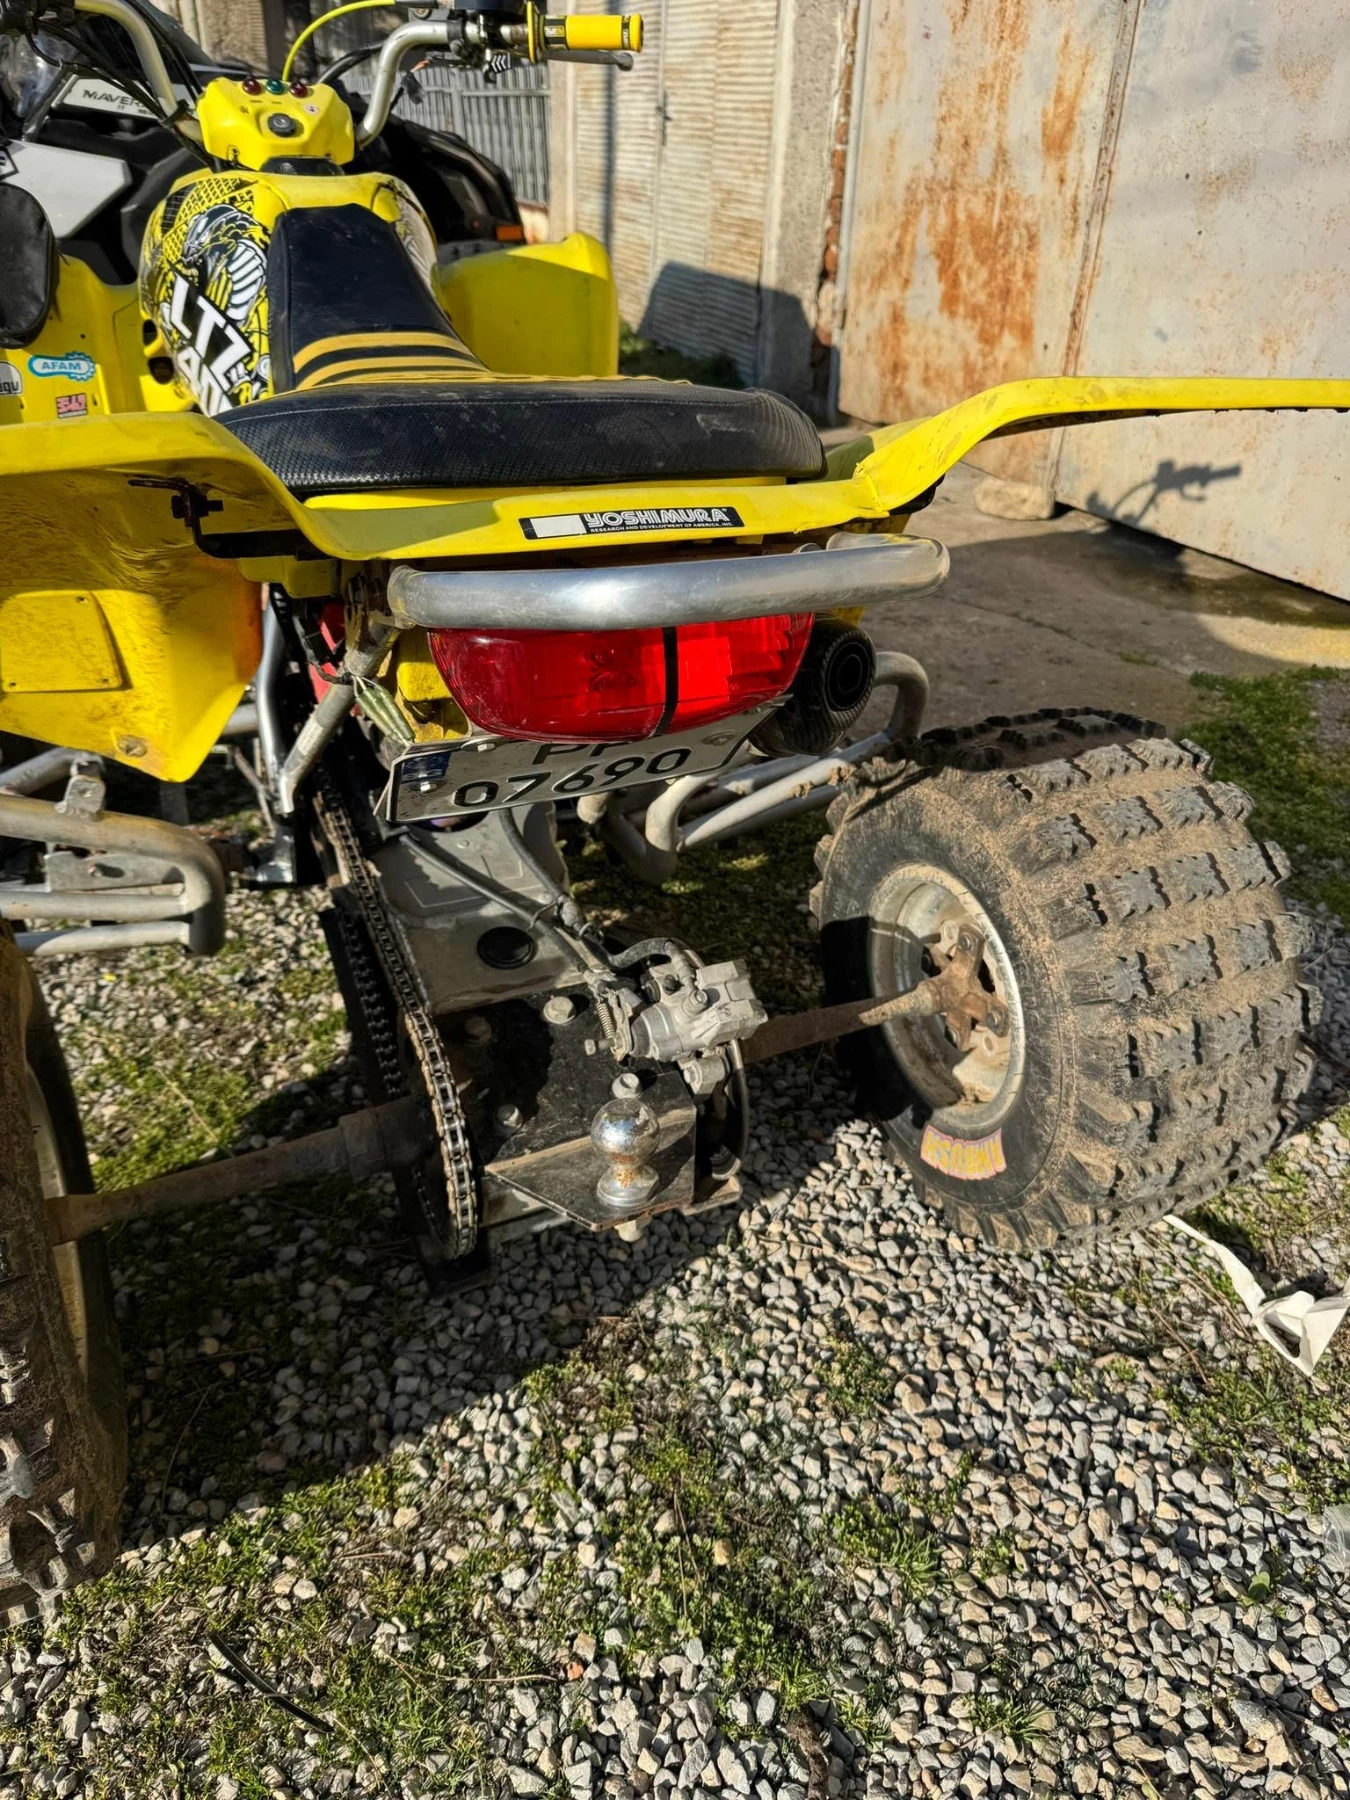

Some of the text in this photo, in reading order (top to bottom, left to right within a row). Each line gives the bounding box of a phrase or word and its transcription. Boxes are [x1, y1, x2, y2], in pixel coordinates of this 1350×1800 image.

[41, 361, 81, 371] AFAM
[584, 508, 730, 528] YOSHIMURA
[590, 525, 625, 533] RESEARCH
[640, 522, 683, 530] DEVELOPMENT
[453, 748, 692, 807] 07690
[922, 1126, 1006, 1179] AMBUSH
